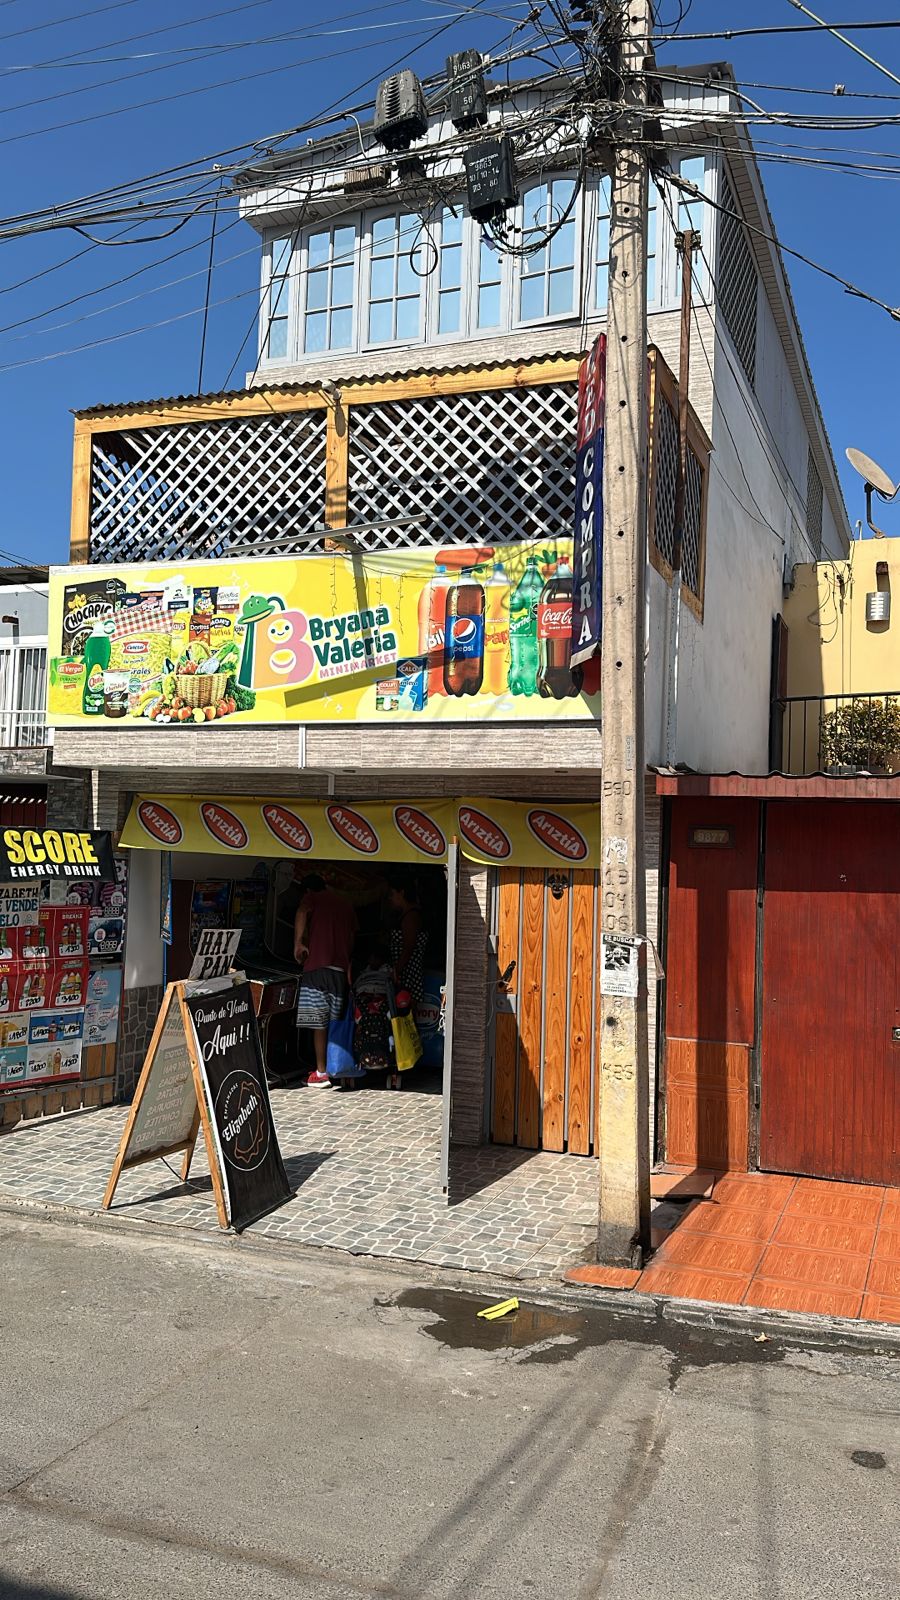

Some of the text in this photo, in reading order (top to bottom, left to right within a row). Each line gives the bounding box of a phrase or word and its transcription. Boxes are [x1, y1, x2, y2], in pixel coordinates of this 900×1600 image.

[64, 603, 112, 632] CHOCAPIC
[308, 606, 390, 642] Bryana
[510, 616, 532, 633] Sprite
[313, 629, 397, 667] Valeria
[453, 645, 474, 653] pepsi
[319, 652, 398, 679] MINIMARKET
[3, 829, 99, 864] SCORE
[10, 863, 101, 878] ENERGY DRINK
[5, 899, 38, 912] VENDE
[198, 930, 235, 956] HAY
[612, 935, 633, 945] BUSCA
[197, 953, 234, 980] PAN
[194, 1008, 217, 1028] Punto
[218, 1006, 227, 1019] de
[226, 999, 249, 1018] Venta
[221, 1094, 258, 1142] Elizabeth
